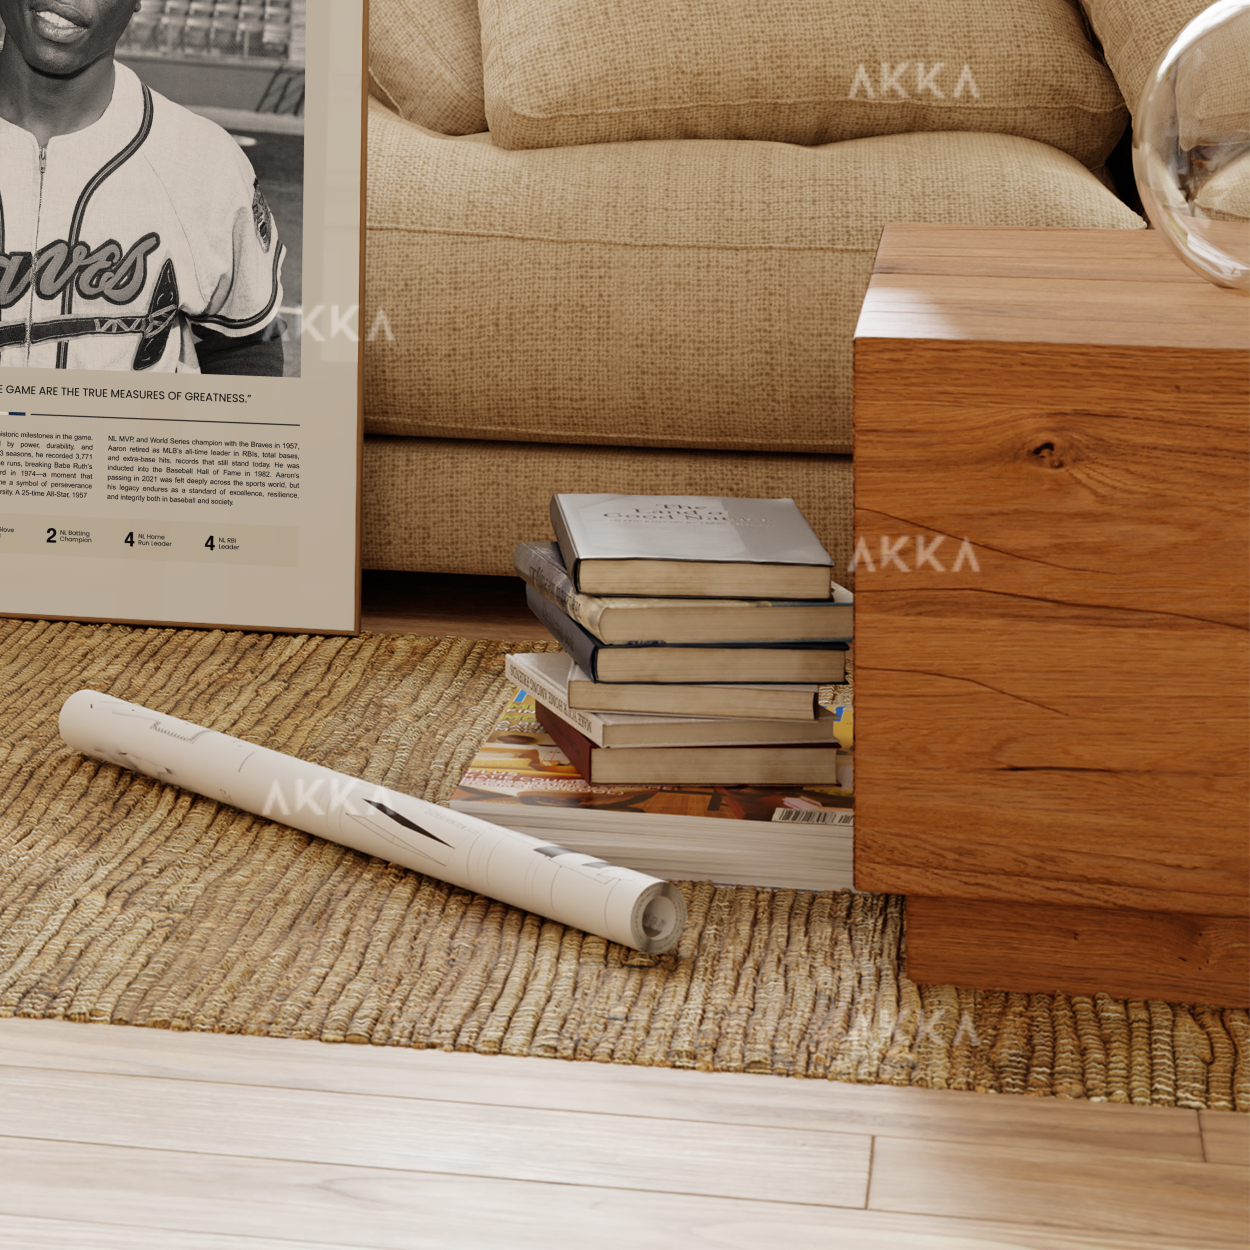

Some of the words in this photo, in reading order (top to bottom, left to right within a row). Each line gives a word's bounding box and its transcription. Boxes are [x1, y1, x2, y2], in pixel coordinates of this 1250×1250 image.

[6, 385, 36, 395] GAME
[38, 386, 59, 396] ARE
[61, 387, 80, 397] THE
[82, 387, 108, 398] TRUE
[110, 389, 165, 400] MEASURES
[168, 391, 183, 401] OF
[118, 435, 135, 443] MVP,
[170, 437, 191, 445] Series
[192, 439, 223, 447] champion
[250, 441, 273, 449] Braves
[282, 442, 300, 450] 1957,
[24, 461, 52, 470] breaking
[54, 461, 71, 469] Babe
[73, 462, 93, 470] Ruth's
[107, 475, 132, 483] passing
[141, 475, 157, 483] 2021
[174, 476, 185, 484] felt
[186, 478, 208, 486] deeply
[268, 481, 287, 489] world,
[46, 527, 57, 544] 2
[59, 535, 93, 544] Champion
[60, 530, 68, 538] NL
[68, 530, 91, 539] Batting
[124, 531, 136, 548] 4
[138, 533, 146, 541] NL
[146, 533, 166, 541] Home
[204, 535, 216, 551] 4
[218, 537, 226, 545] NL
[227, 537, 237, 545] RBI
[218, 543, 240, 551] Leader
